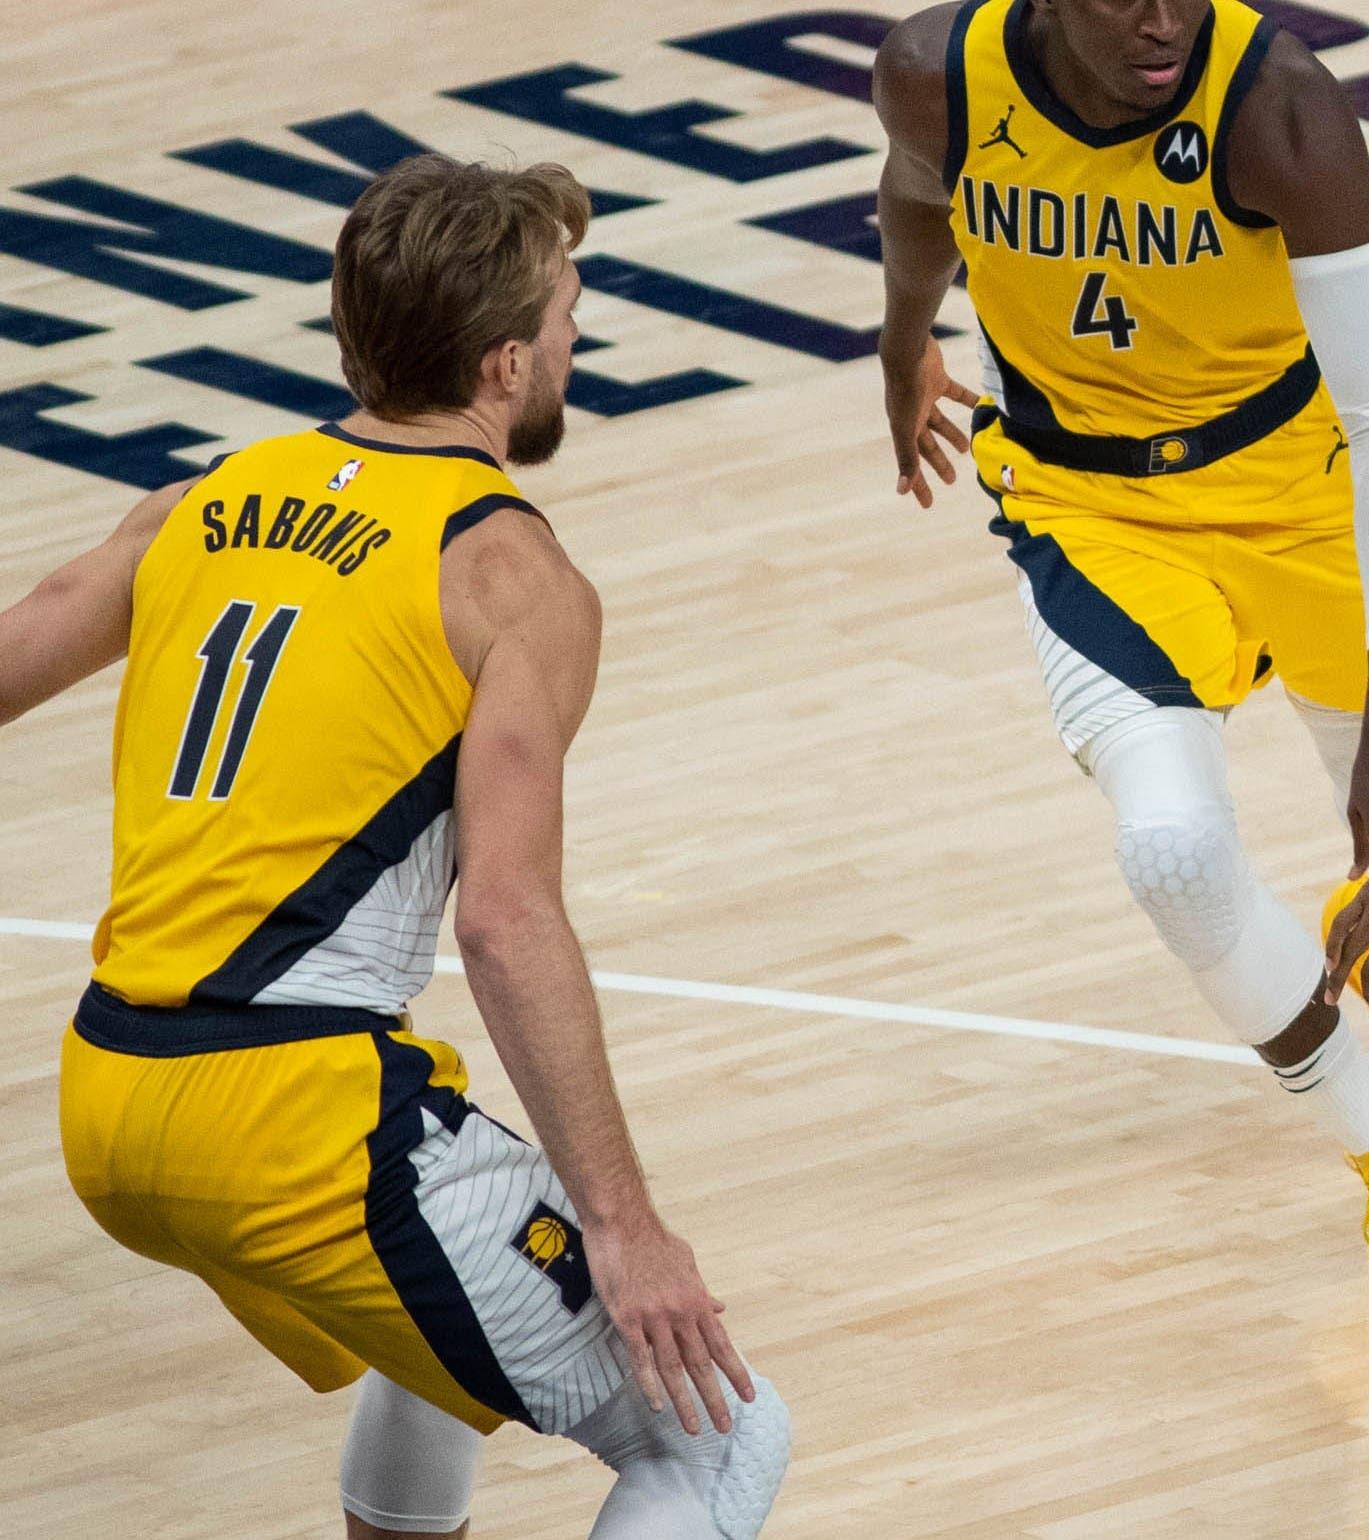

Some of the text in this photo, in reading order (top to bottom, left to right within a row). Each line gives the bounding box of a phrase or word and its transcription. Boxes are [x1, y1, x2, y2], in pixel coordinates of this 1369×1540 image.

[961, 174, 1225, 267] INDIANA
[1071, 271, 1139, 351] 4
[202, 494, 392, 577] SABONIS
[166, 598, 303, 801] 11
